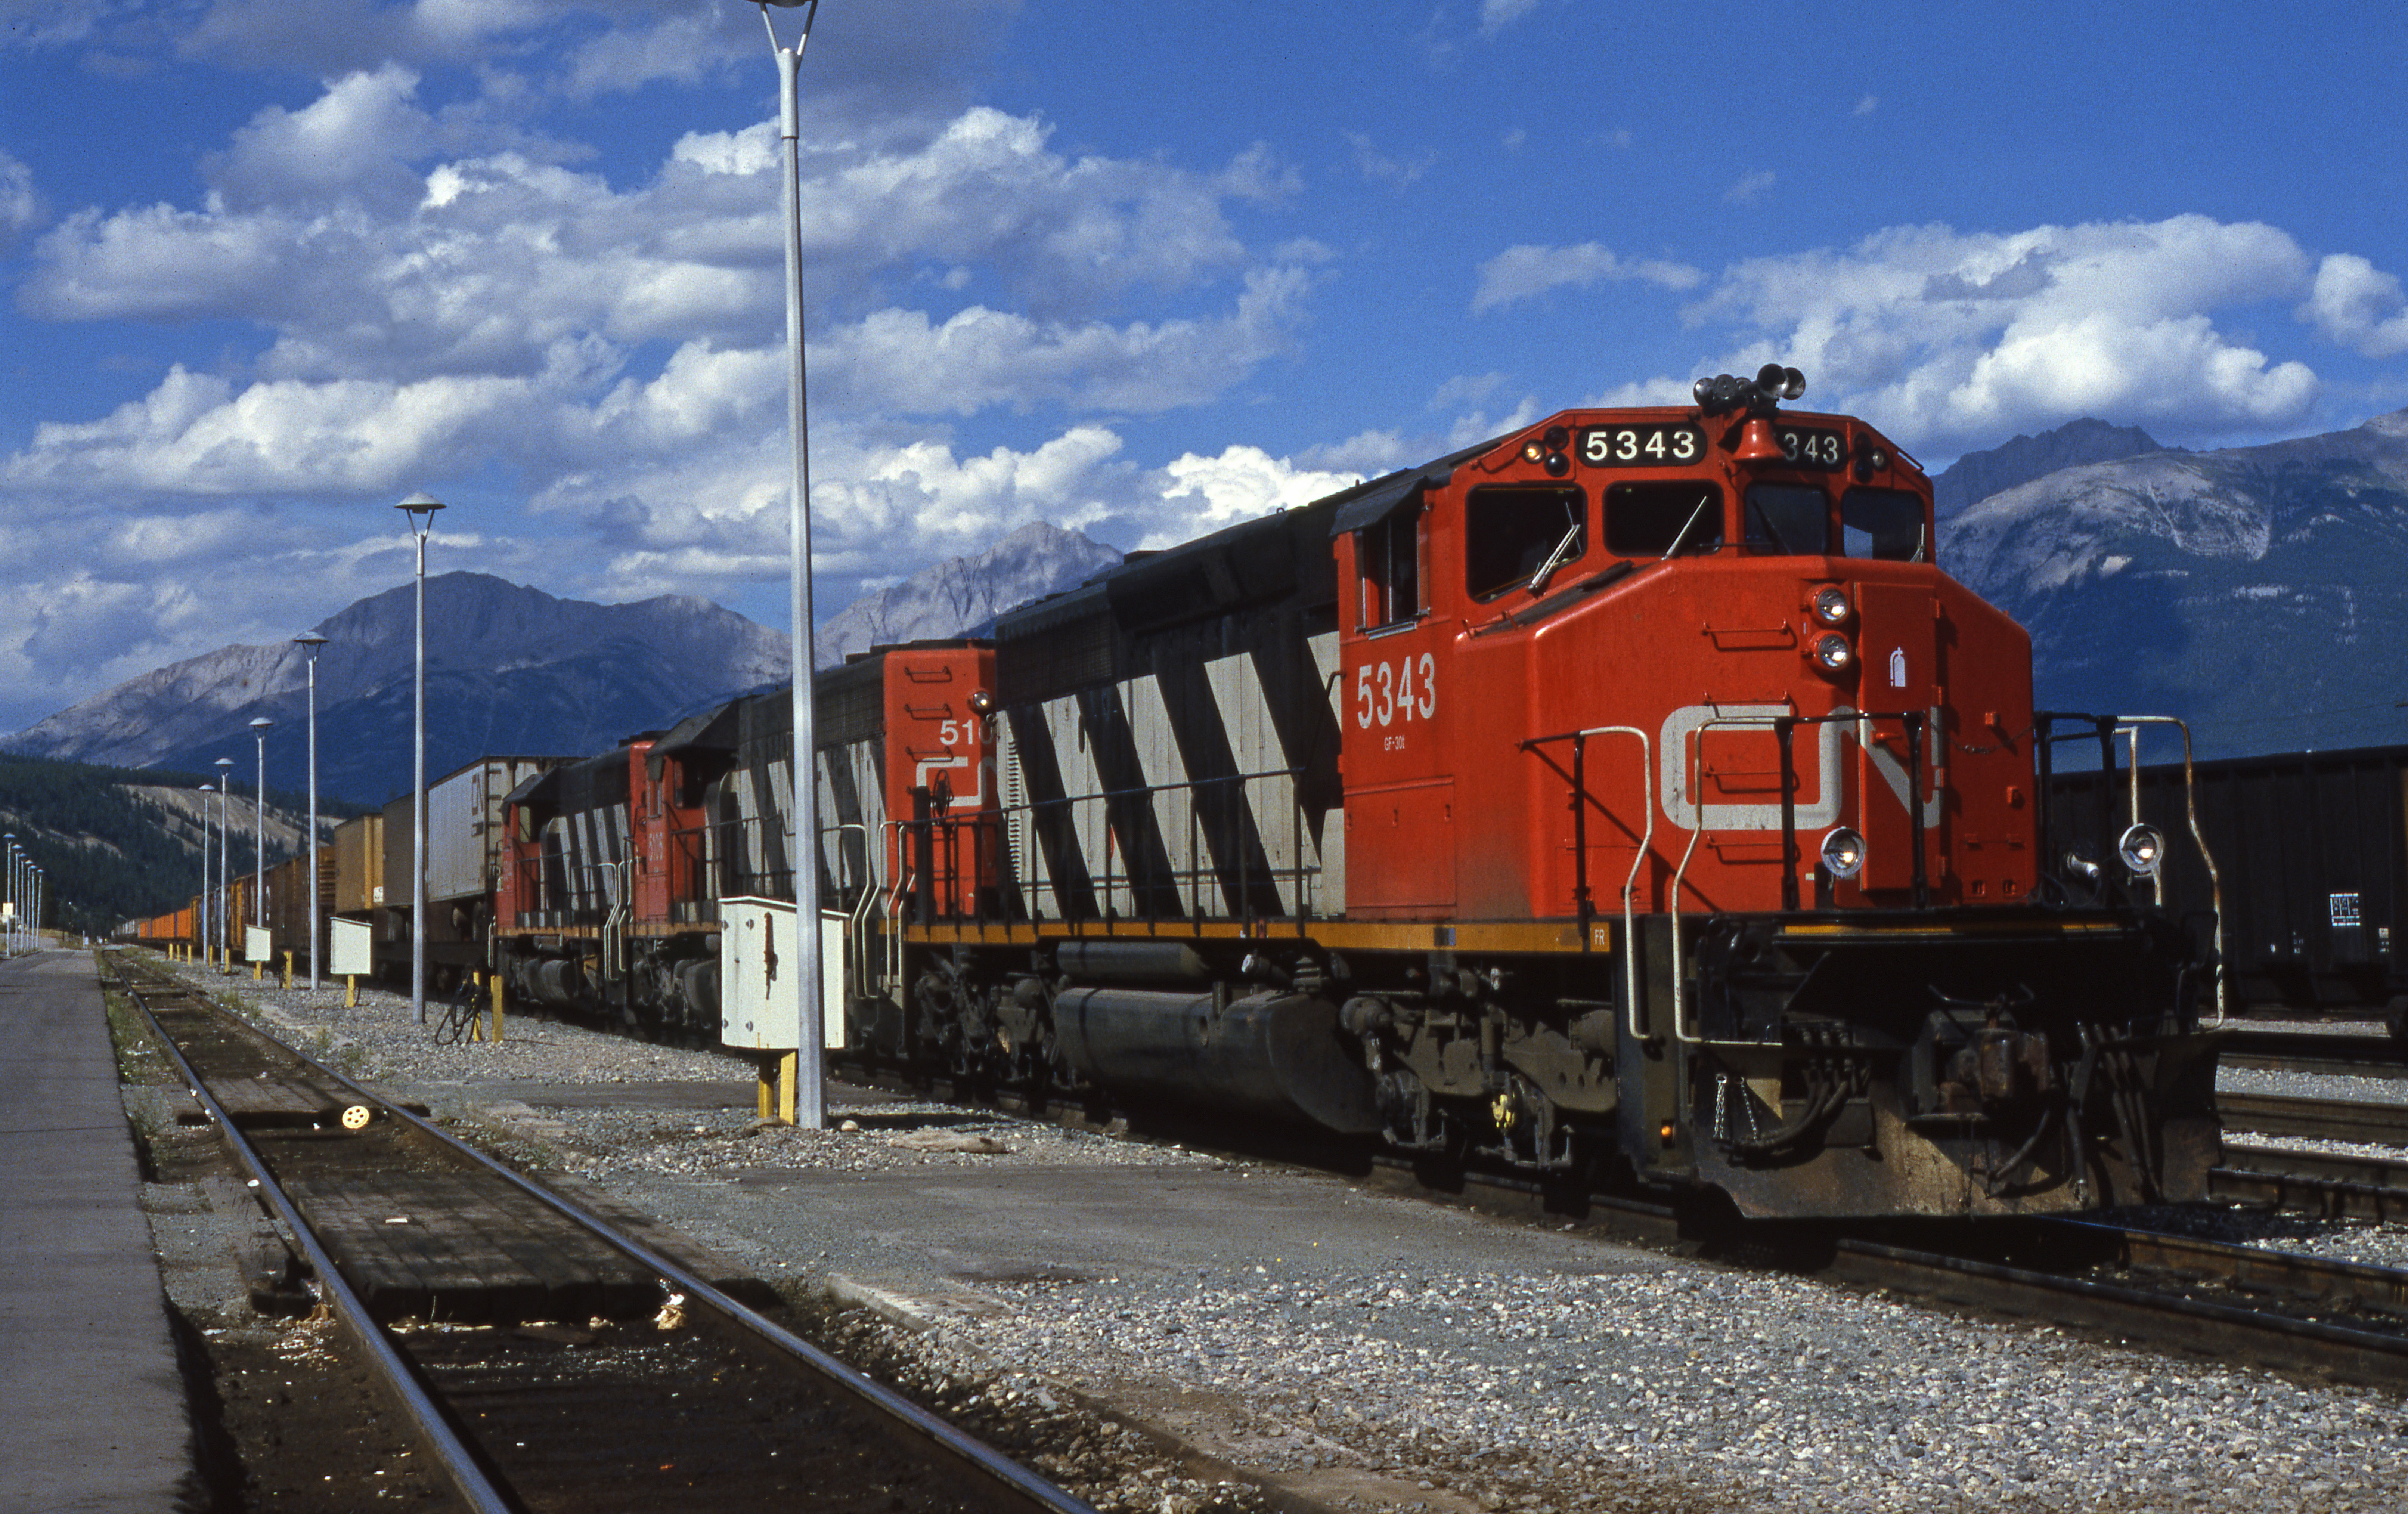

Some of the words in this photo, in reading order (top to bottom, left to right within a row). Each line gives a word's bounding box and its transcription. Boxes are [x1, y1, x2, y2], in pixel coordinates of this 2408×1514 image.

[1586, 431, 1694, 460] 5343
[1784, 433, 1838, 464] 343
[1358, 652, 1435, 729] 5343
[1660, 705, 1941, 830] CN
[1595, 929, 1605, 945] FR
